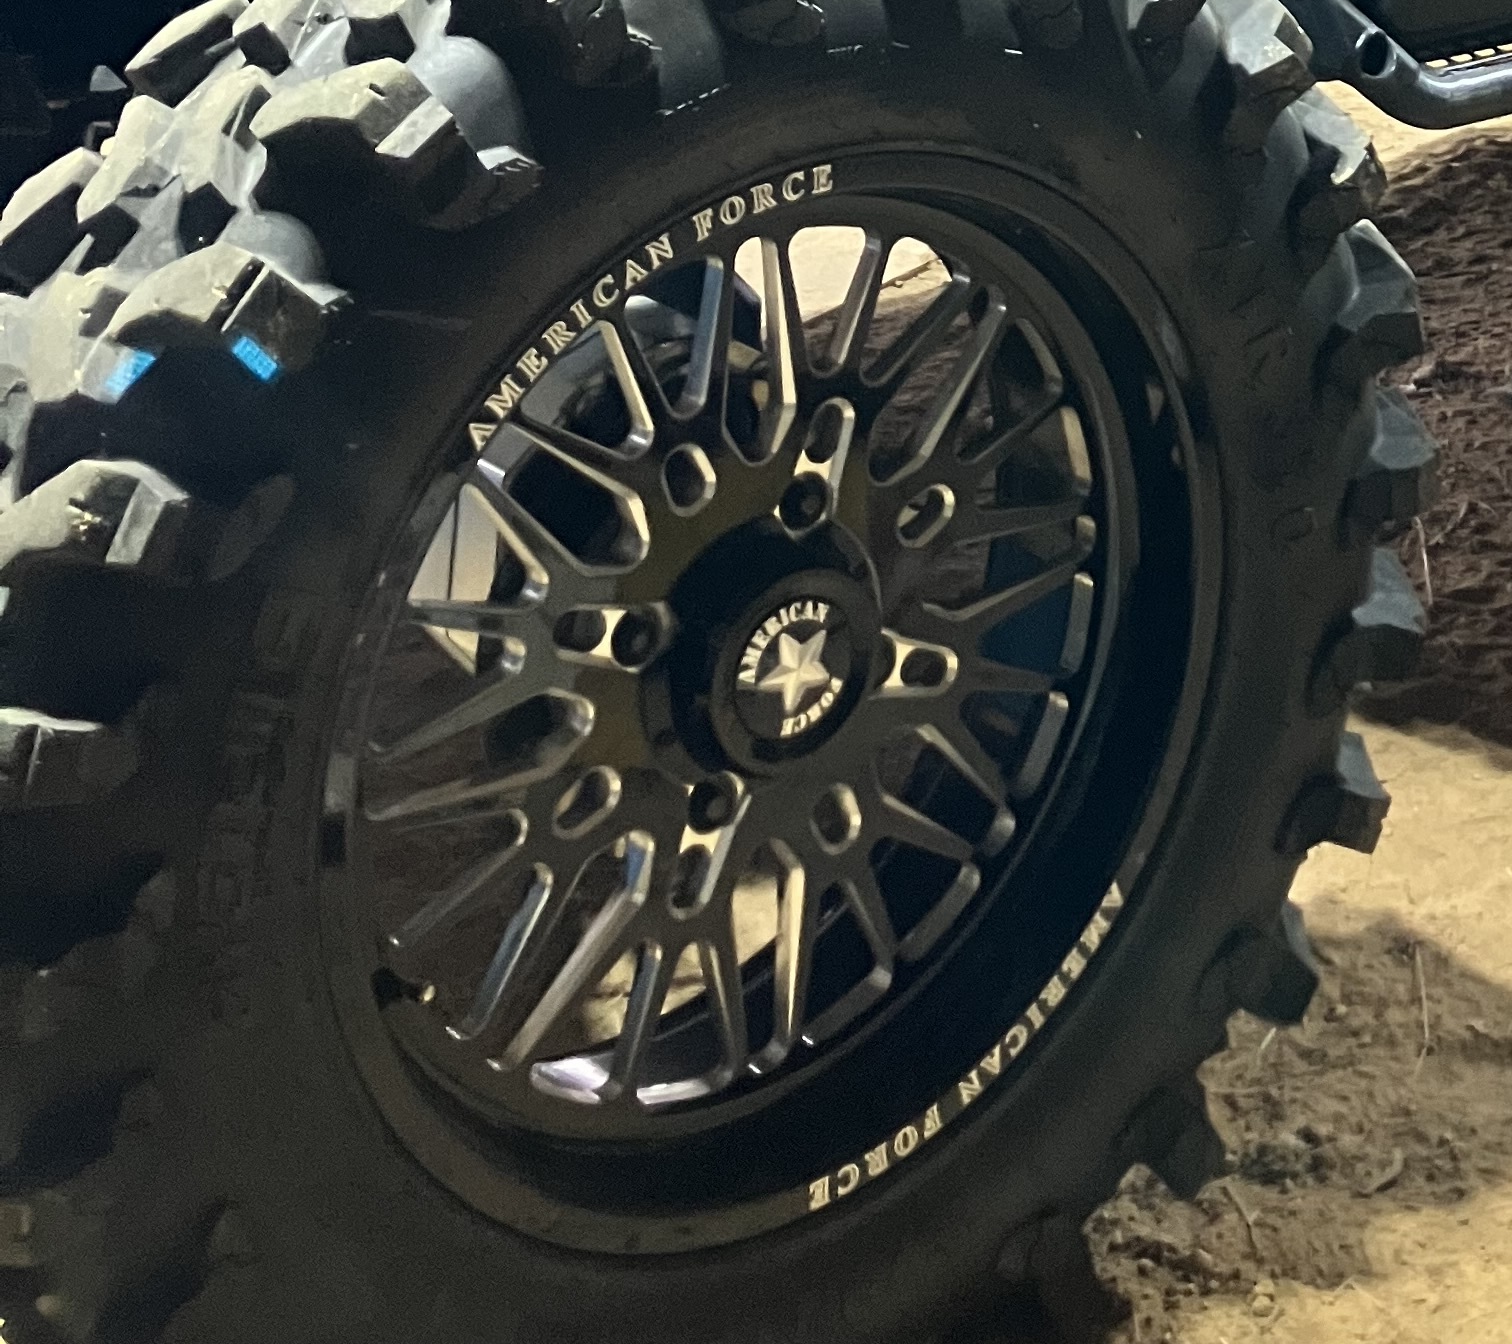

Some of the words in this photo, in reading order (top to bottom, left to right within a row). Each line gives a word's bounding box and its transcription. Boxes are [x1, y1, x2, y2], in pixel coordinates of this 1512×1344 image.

[467, 232, 677, 452] AMERICAN
[691, 163, 835, 243] FORCE
[956, 880, 1125, 1107] AMERICAN
[807, 1102, 944, 1212] FORCE
